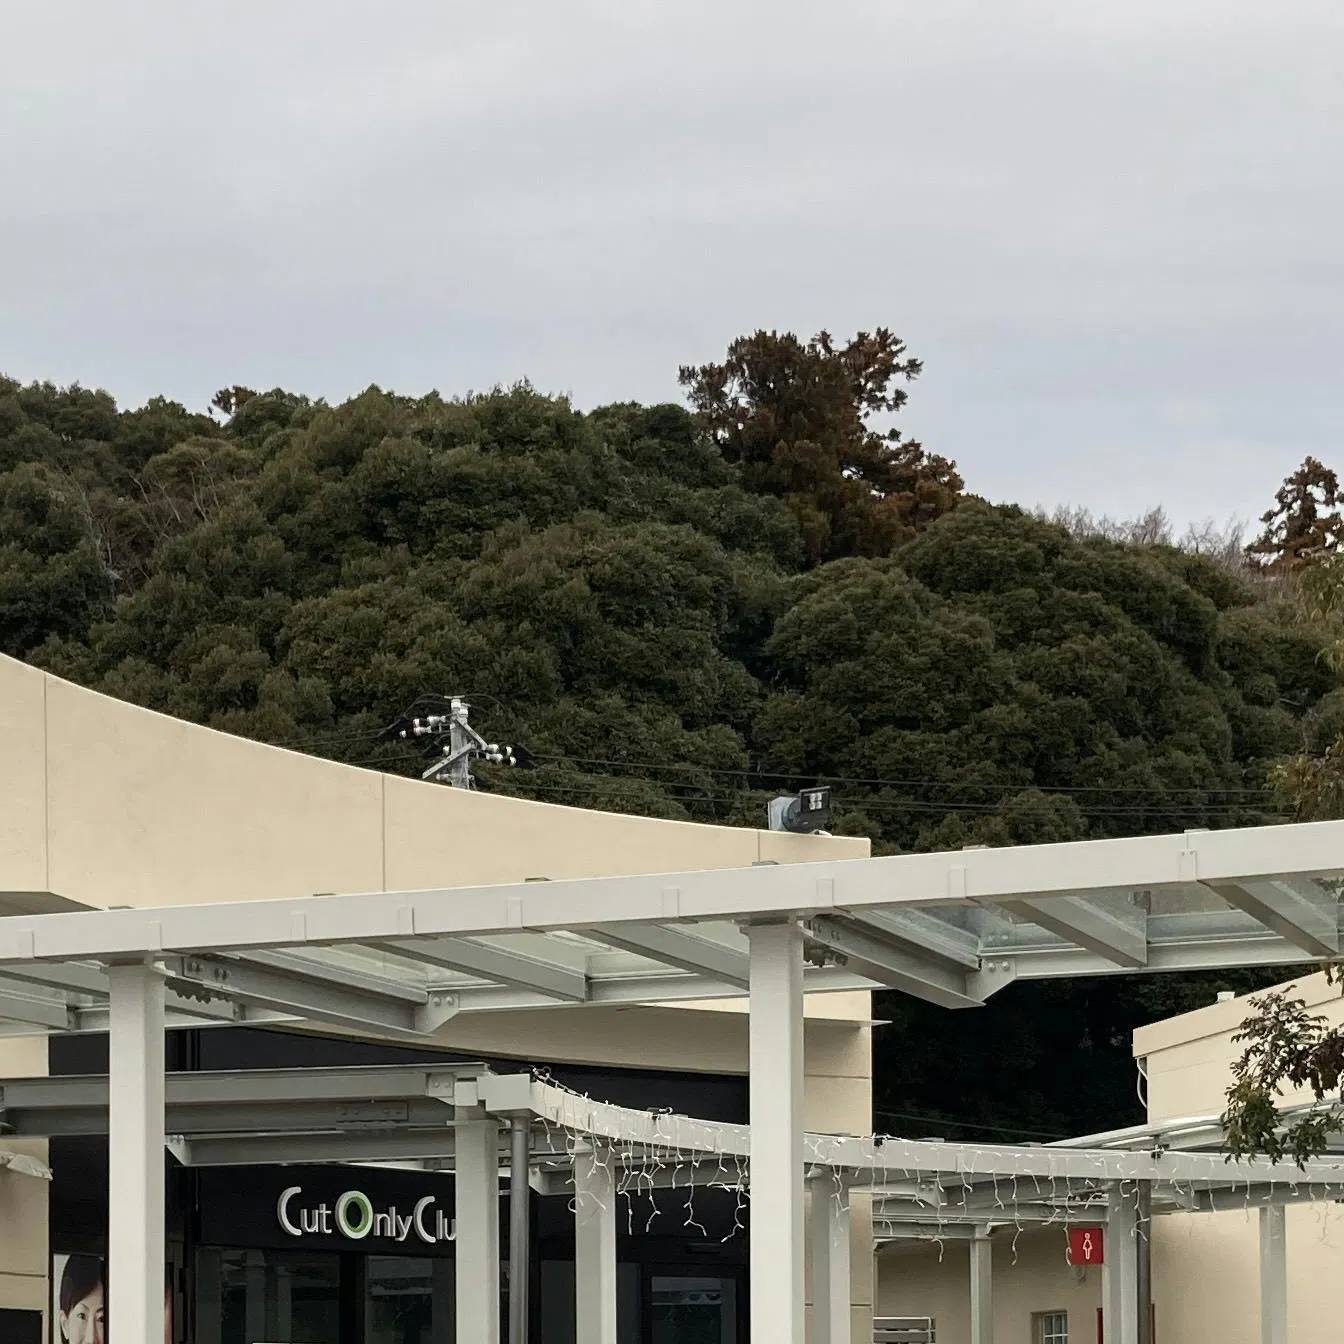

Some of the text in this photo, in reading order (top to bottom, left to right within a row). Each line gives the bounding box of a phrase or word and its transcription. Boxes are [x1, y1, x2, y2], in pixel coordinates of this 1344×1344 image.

[277, 1186, 456, 1243] Cut Only Clu
